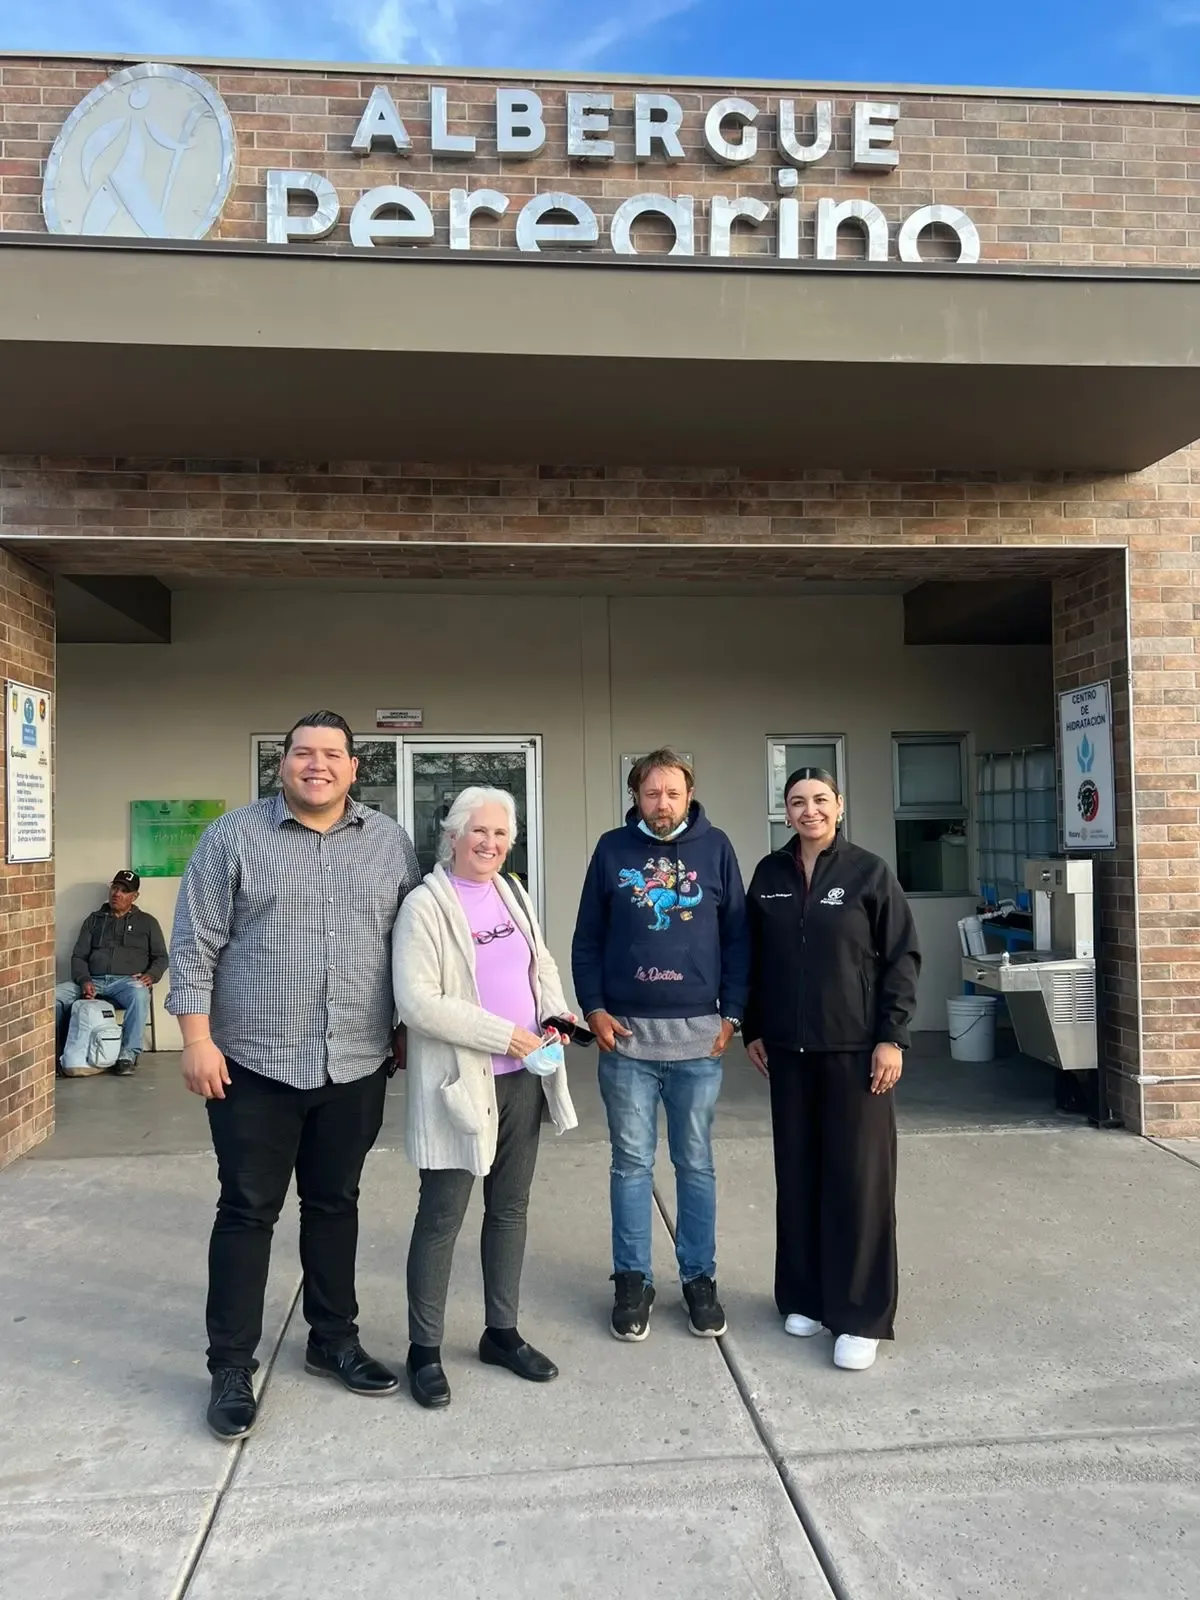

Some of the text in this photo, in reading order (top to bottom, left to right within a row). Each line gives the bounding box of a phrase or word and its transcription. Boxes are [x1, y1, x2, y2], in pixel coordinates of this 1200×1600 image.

[350, 84, 901, 172] ALBERGUE
[1071, 689, 1096, 704] CENTRO
[1080, 705, 1089, 716] DE
